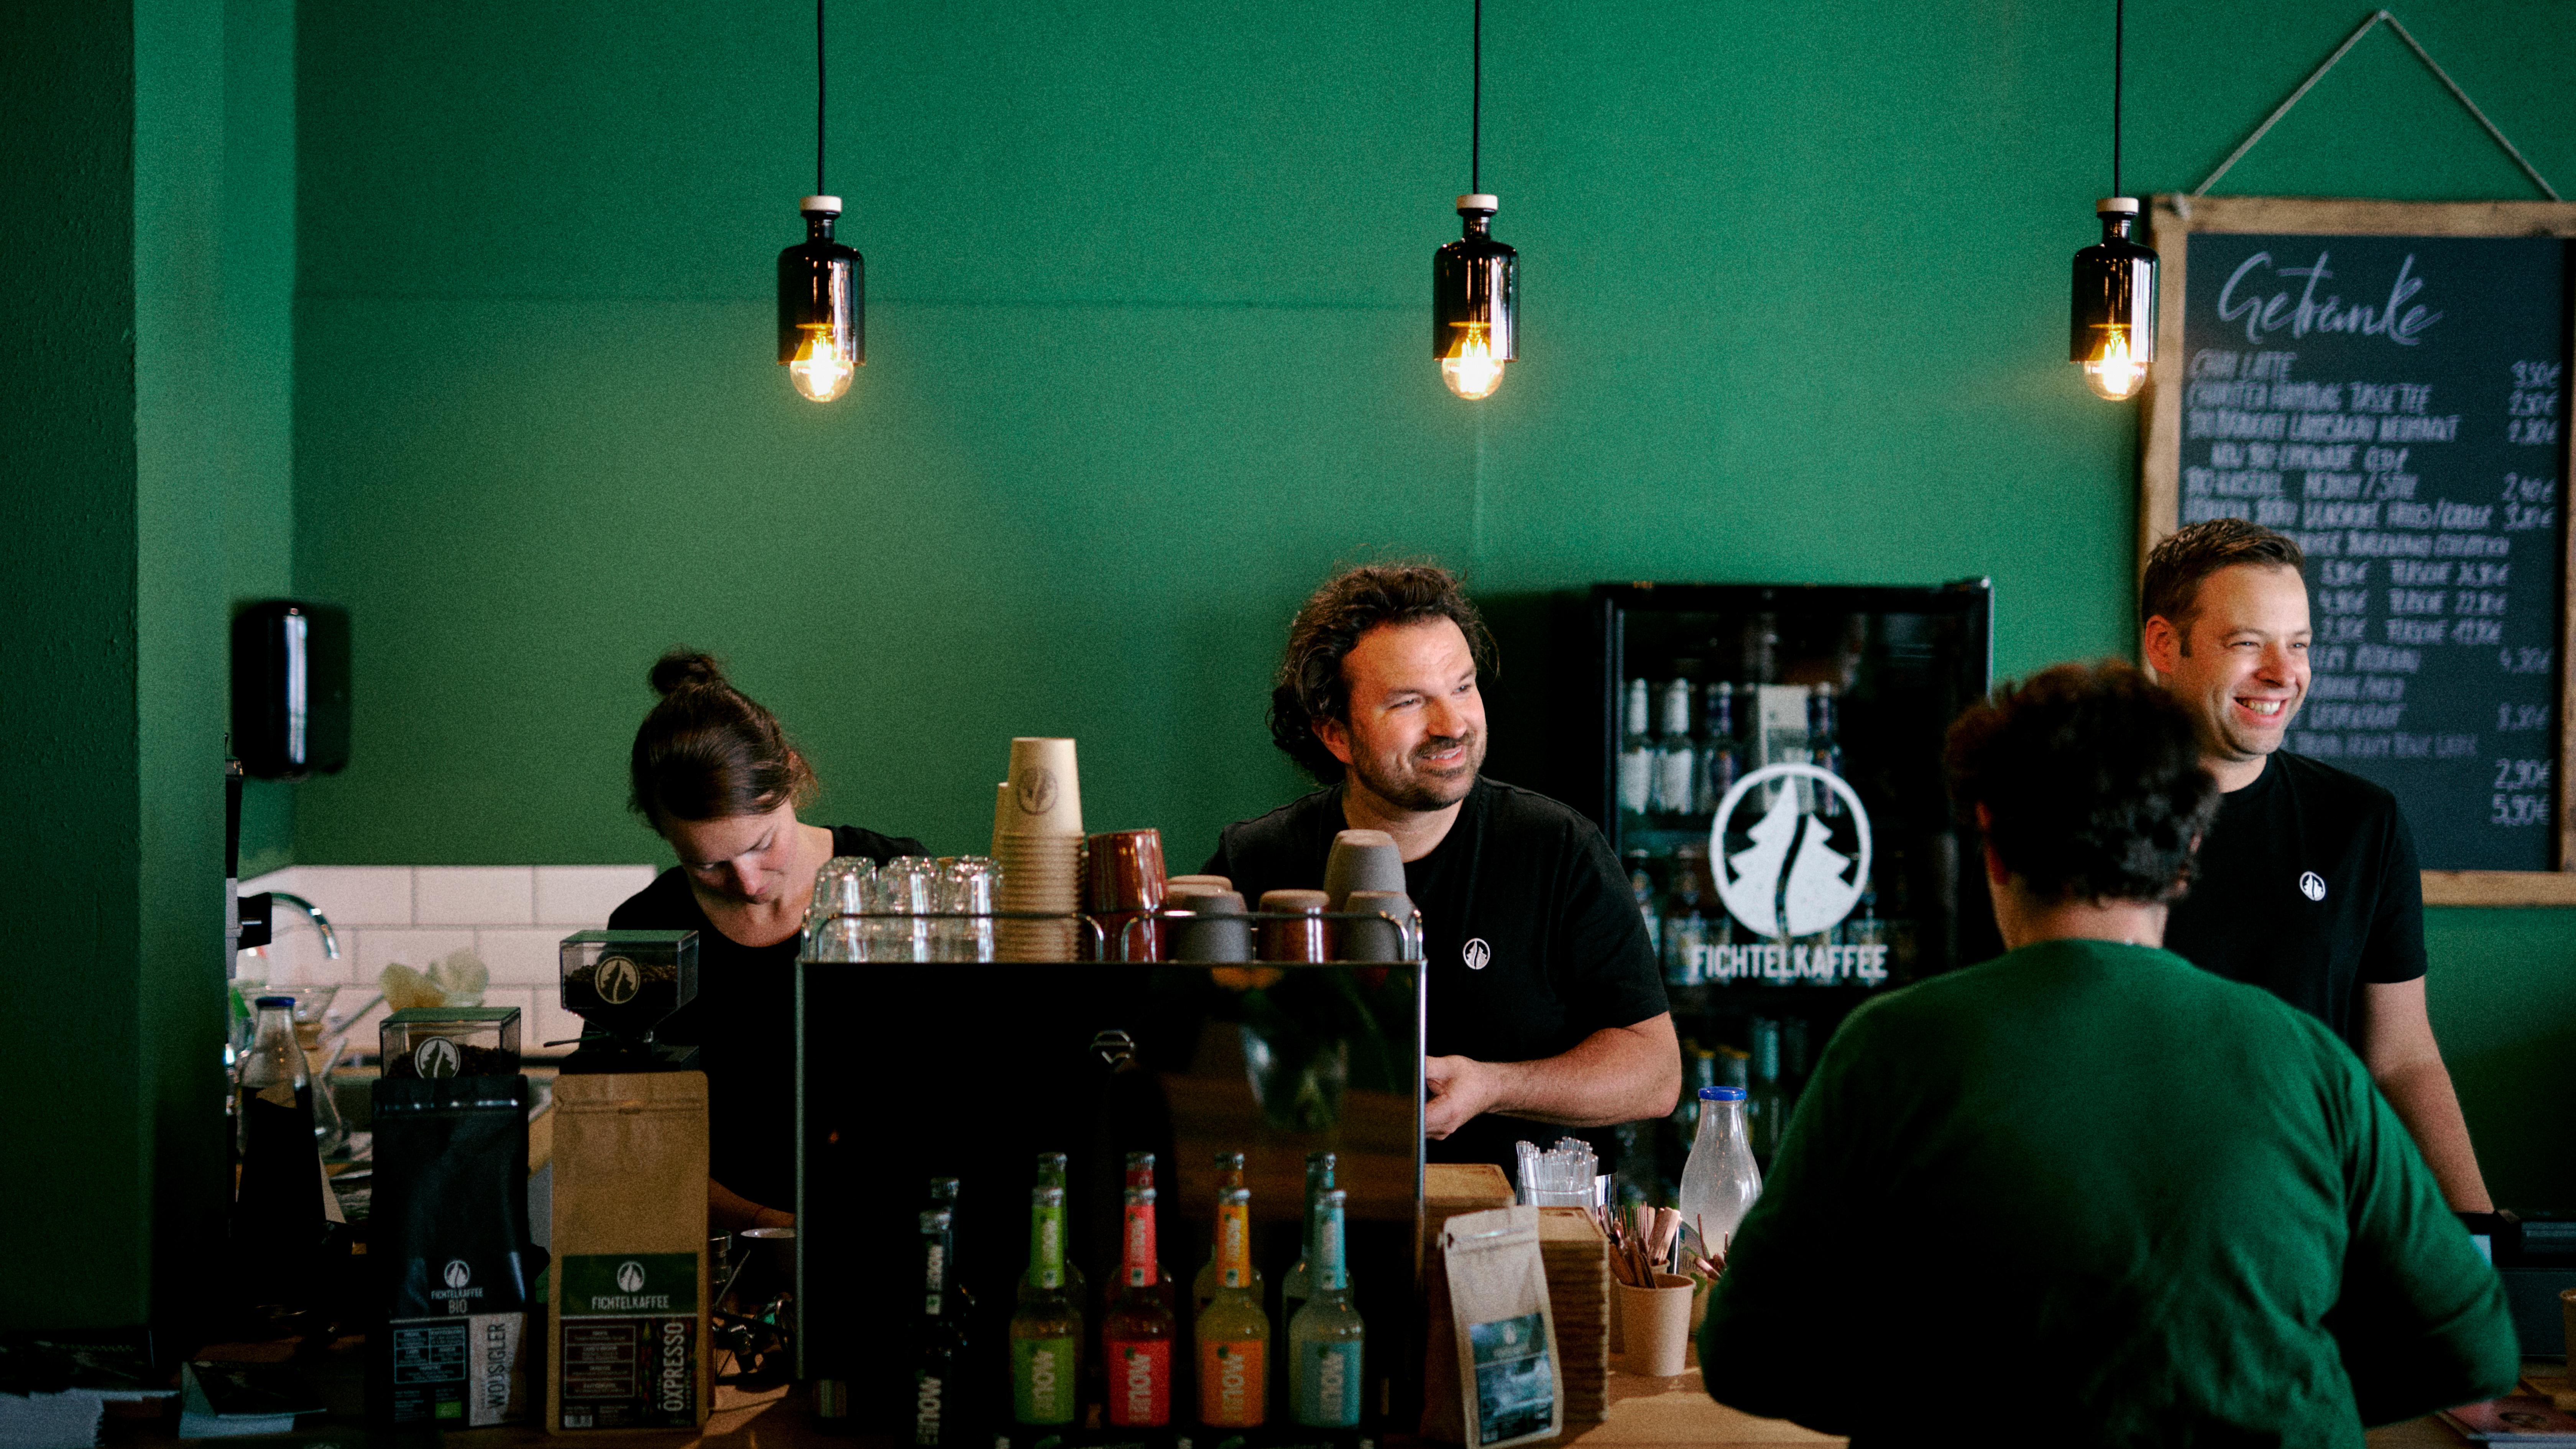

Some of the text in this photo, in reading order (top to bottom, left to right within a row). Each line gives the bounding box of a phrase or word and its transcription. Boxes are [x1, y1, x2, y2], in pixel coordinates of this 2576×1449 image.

[1692, 944, 1888, 978] FICHTELKAFFEE
[431, 1287, 483, 1300] FICHTELKAFFEE
[448, 1299, 468, 1314] BIO
[591, 1294, 669, 1310] FICHTELKAFFEE
[663, 1322, 685, 1411] OXPRESSO
